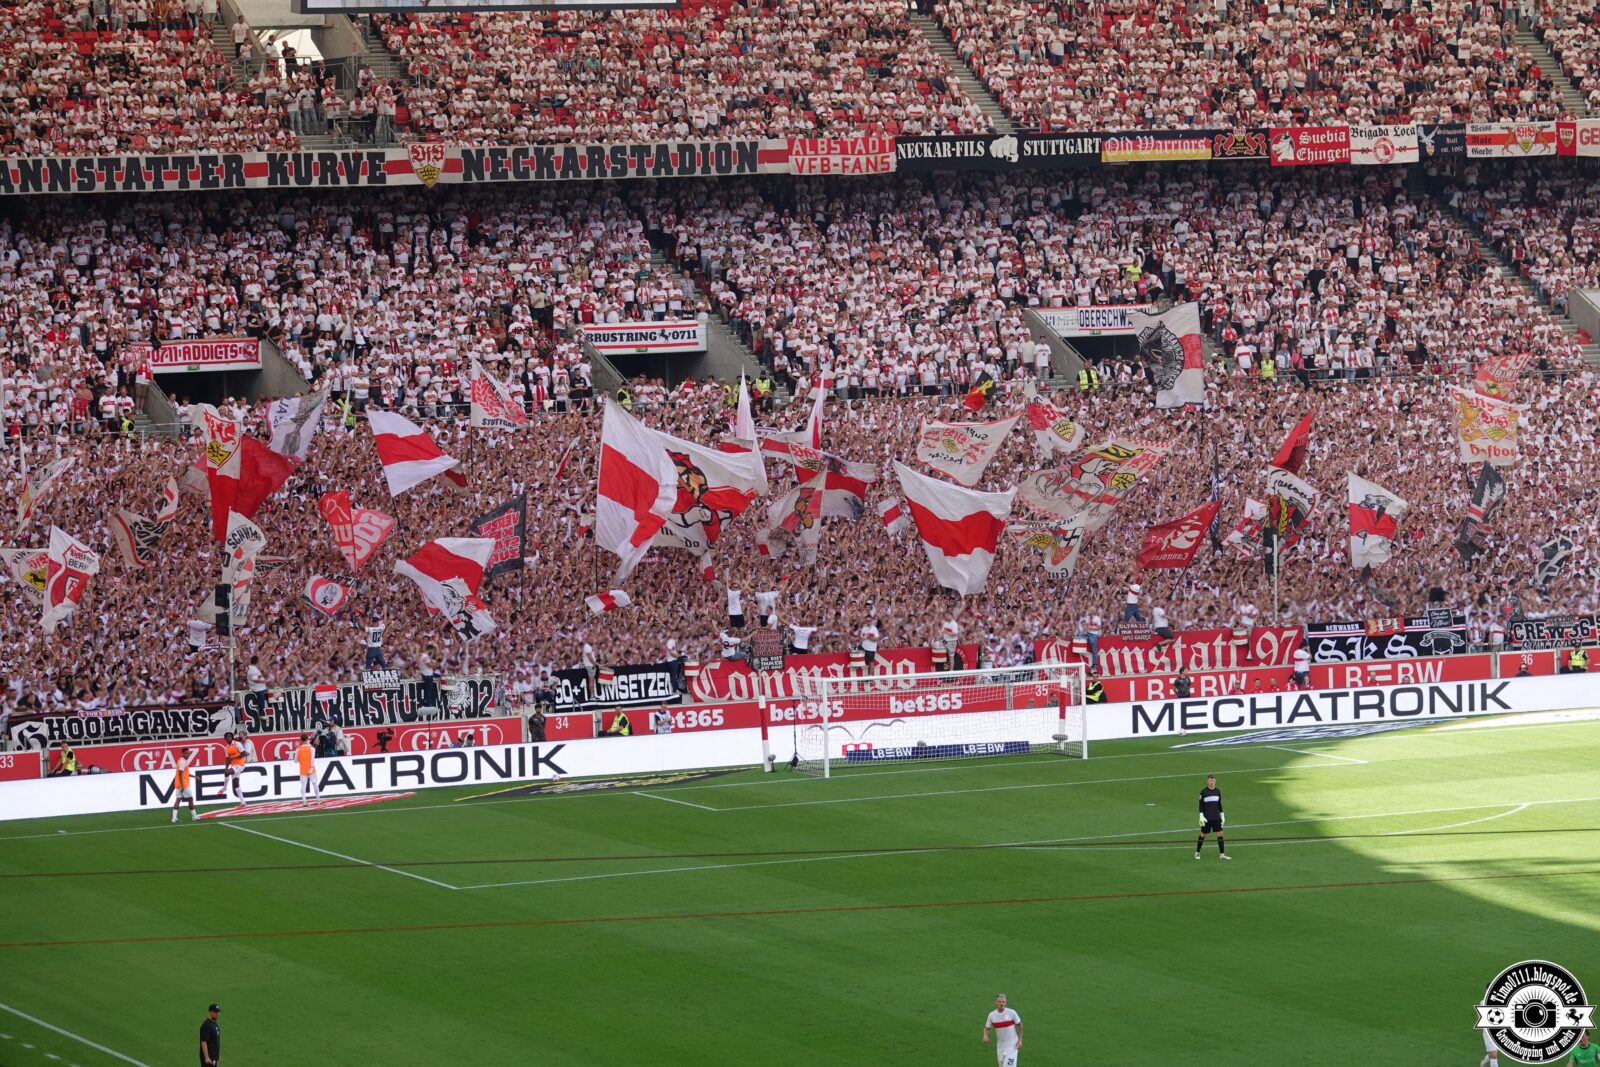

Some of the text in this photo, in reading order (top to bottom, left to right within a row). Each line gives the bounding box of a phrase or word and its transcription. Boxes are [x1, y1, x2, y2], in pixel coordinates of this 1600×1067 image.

[1299, 130, 1346, 145] Suebia
[1351, 125, 1416, 140] Brigada Loca
[792, 137, 892, 156] ALBSTADT
[896, 137, 1102, 159] NECKAR-FILS STUTTGART
[1105, 136, 1132, 156] Old
[1136, 134, 1207, 155] Warriors
[1296, 148, 1349, 163] Ehingen
[267, 151, 387, 188] KURVE
[461, 141, 759, 181] NECKARSTADION
[794, 154, 890, 175] VFB-FANS
[587, 329, 697, 344] BRUSTRING 0711
[1254, 629, 1300, 667] 97
[1035, 684, 1049, 697] 35
[770, 700, 845, 722] bet365
[889, 692, 963, 714] bet365
[1131, 681, 1513, 734] MECHATRONIK
[43, 709, 210, 742] HOOLIGANS
[555, 716, 569, 730] 34
[139, 743, 569, 807] MECHATRONIK
